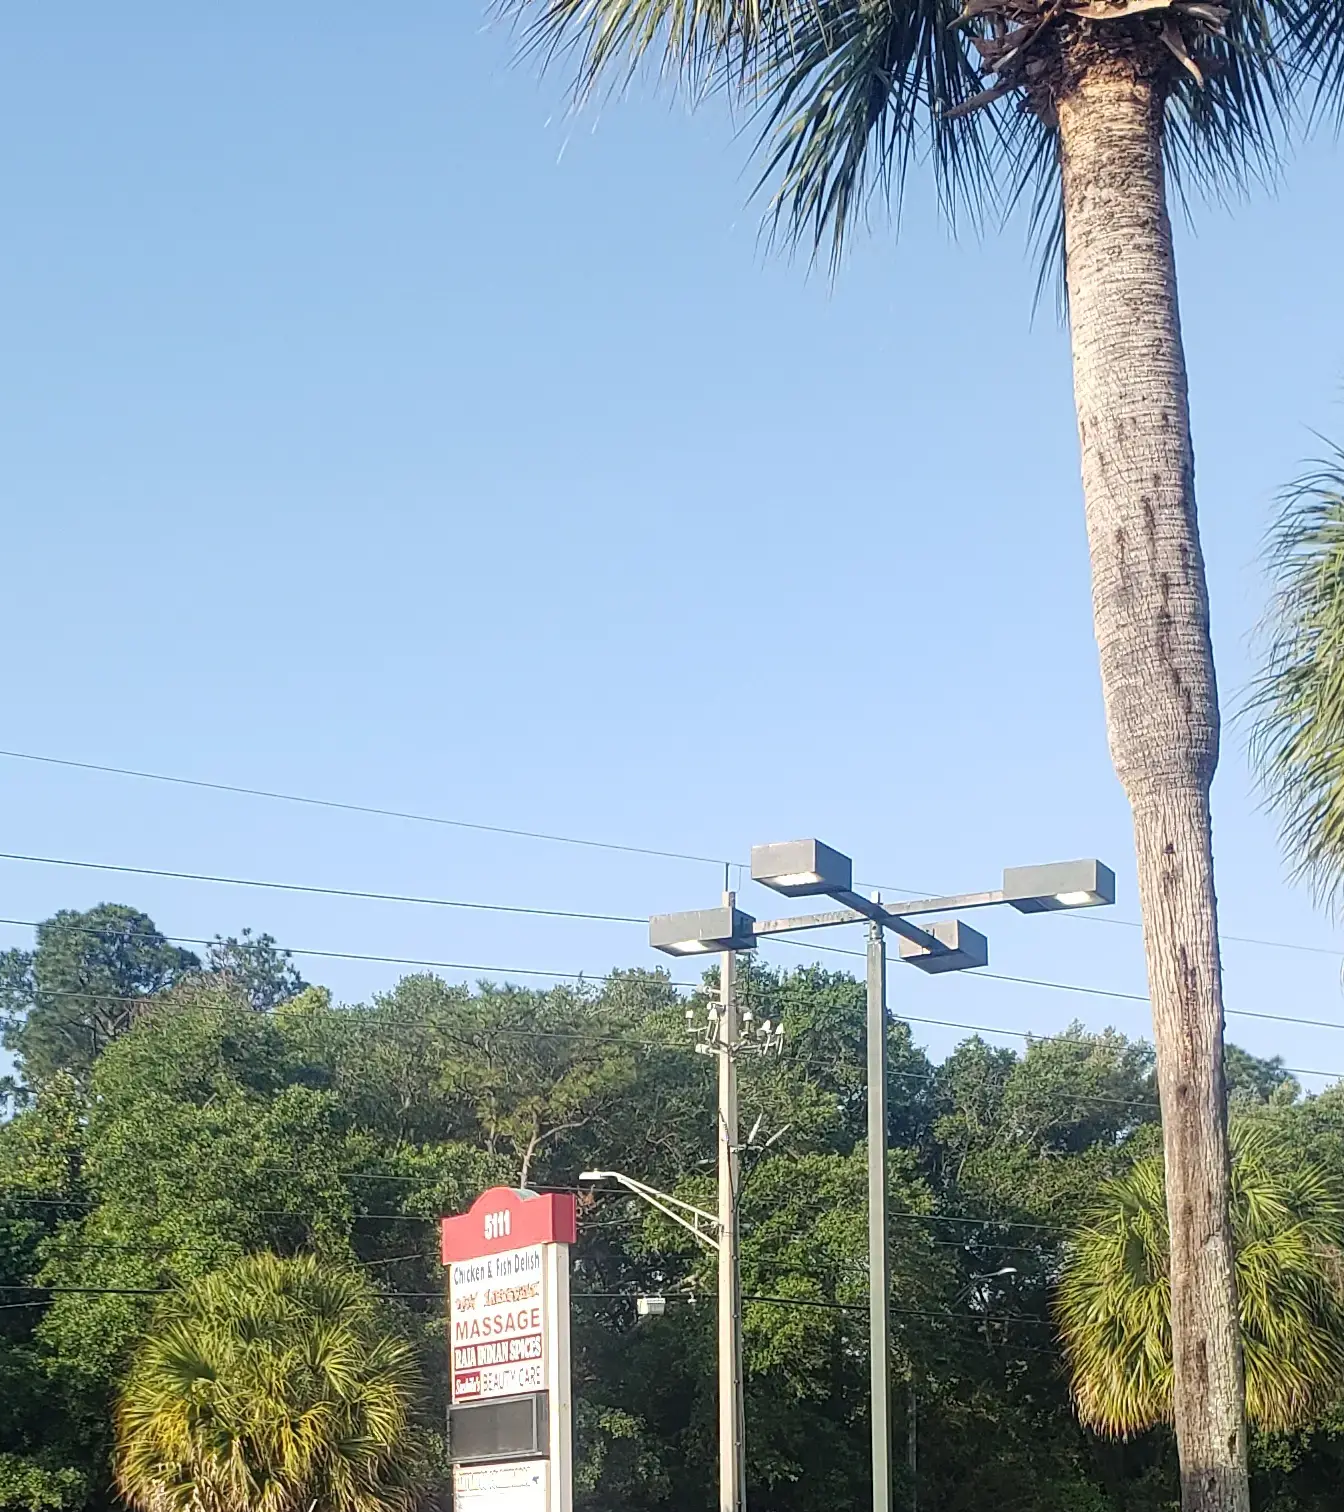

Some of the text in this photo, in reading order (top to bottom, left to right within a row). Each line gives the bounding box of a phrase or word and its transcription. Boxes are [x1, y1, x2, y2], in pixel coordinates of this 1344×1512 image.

[484, 1209, 511, 1240] 5111
[454, 1250, 540, 1286] Chicken & Fish Delish
[456, 1307, 541, 1341] MASSAGE
[483, 1369, 516, 1392] BEAUTY
[519, 1365, 541, 1387] CARE
